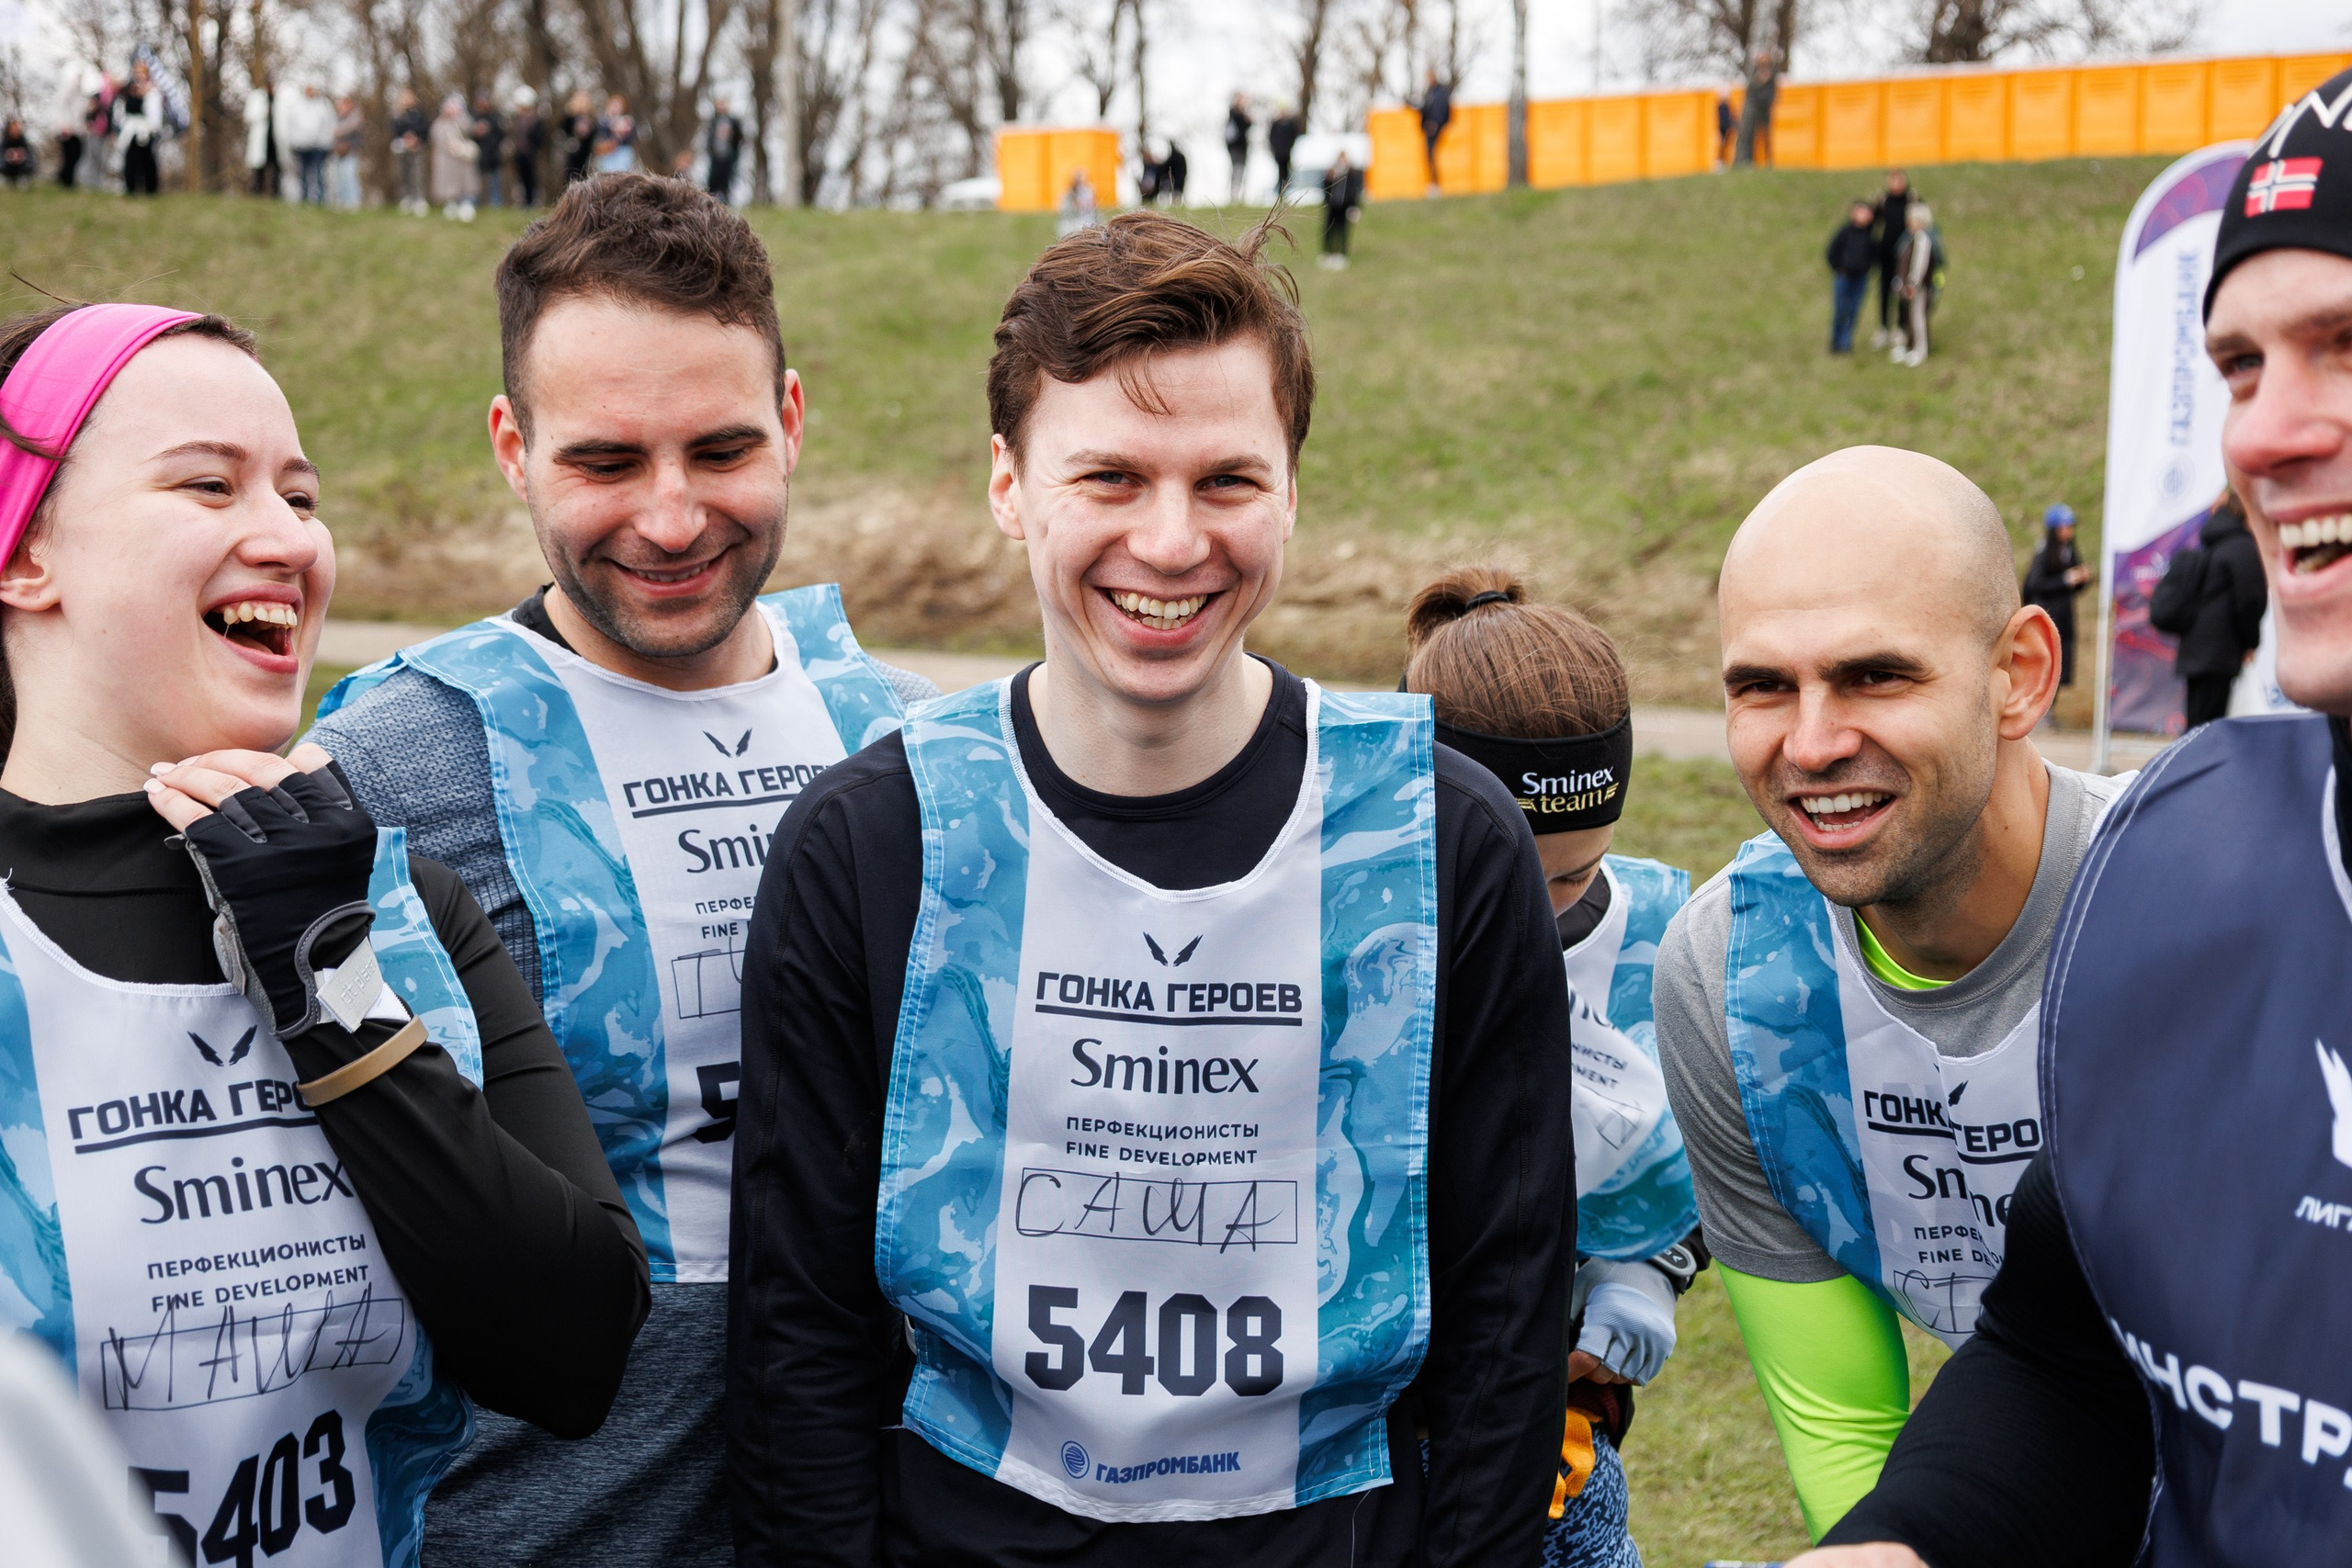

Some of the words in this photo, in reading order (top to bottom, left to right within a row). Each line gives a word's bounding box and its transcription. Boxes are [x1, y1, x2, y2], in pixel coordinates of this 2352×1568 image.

[622, 772, 735, 807] ГОНКА
[738, 764, 831, 795] ГЕРО
[1521, 765, 1614, 795] Sminex
[1540, 789, 1602, 814] team
[678, 823, 774, 874] Smi
[701, 921, 739, 939] FINE
[1035, 971, 1155, 1011] ГОНКА
[1167, 982, 1302, 1013] ГЕРОЕВ
[1070, 1038, 1260, 1094] Sminex
[67, 1089, 217, 1140] ГОНКА
[228, 1078, 316, 1117] ГЕРО
[1067, 1116, 1259, 1141] ПЕРФЕКЦИОНИСТЫ
[1863, 1089, 1954, 1128] ГОНК
[1066, 1141, 1109, 1159] FINE
[1119, 1147, 1258, 1167] DEVELOPMENT
[134, 1156, 355, 1224] Sminex
[1015, 1171, 1284, 1254] САША
[147, 1234, 367, 1280] ПЕРФЕКЦИОНИСТЫ
[1918, 1248, 1963, 1263] FINE
[152, 1290, 205, 1313] FINE
[215, 1265, 369, 1303] DEVELOPMENT
[1024, 1284, 1284, 1397] 5408
[1095, 1451, 1241, 1484] ГАЗПРОМБАНК
